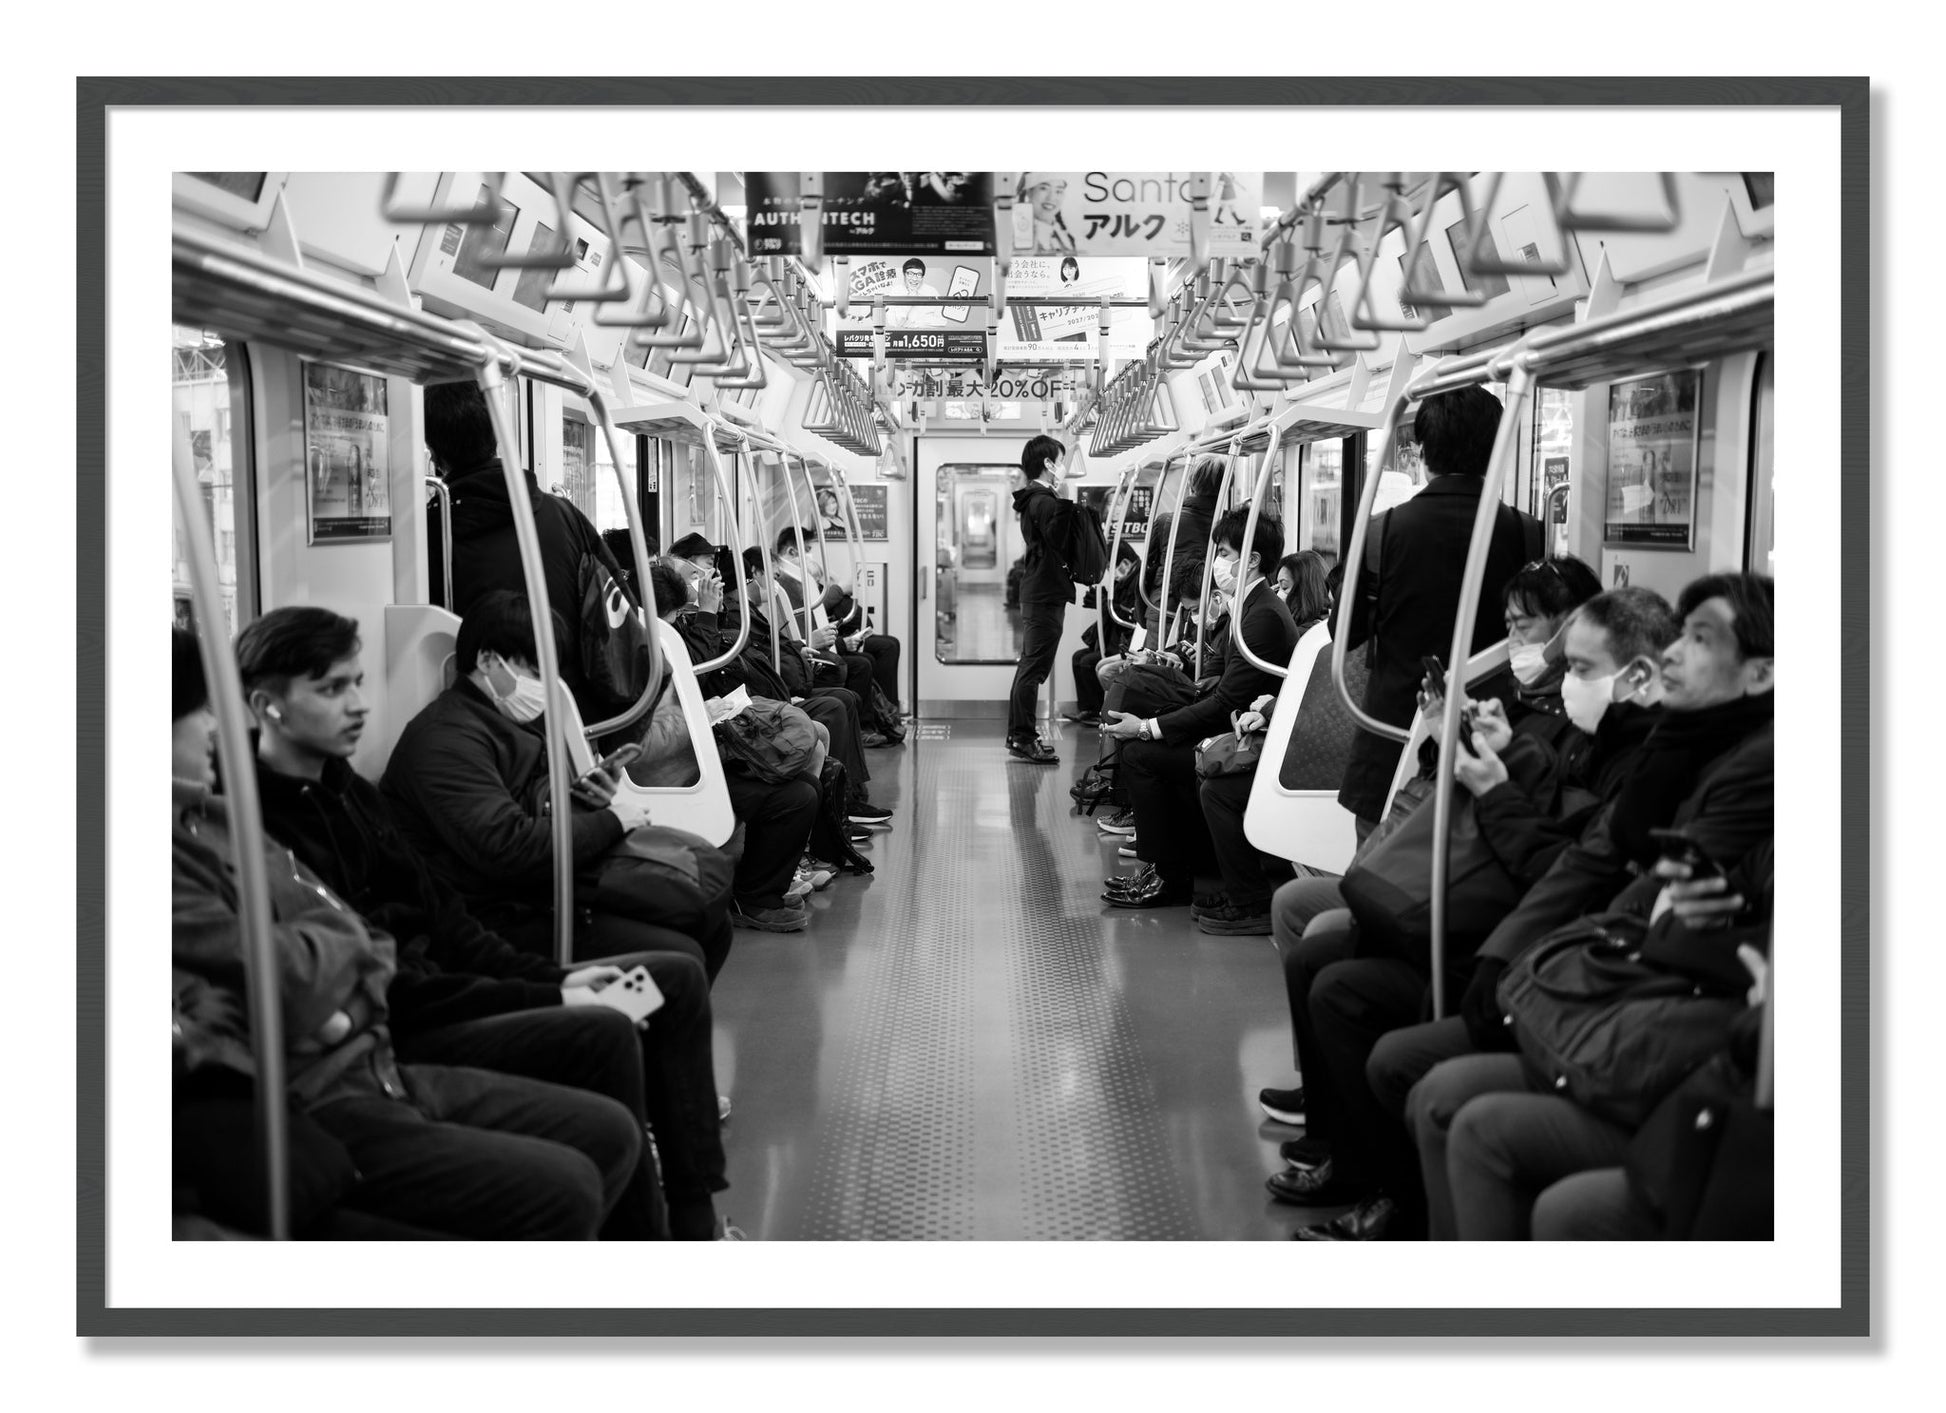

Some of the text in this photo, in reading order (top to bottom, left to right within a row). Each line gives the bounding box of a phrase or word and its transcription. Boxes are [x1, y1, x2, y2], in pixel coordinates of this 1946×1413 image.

[754, 211, 875, 226] AUTHTECH
[1083, 214, 1166, 241] アルク
